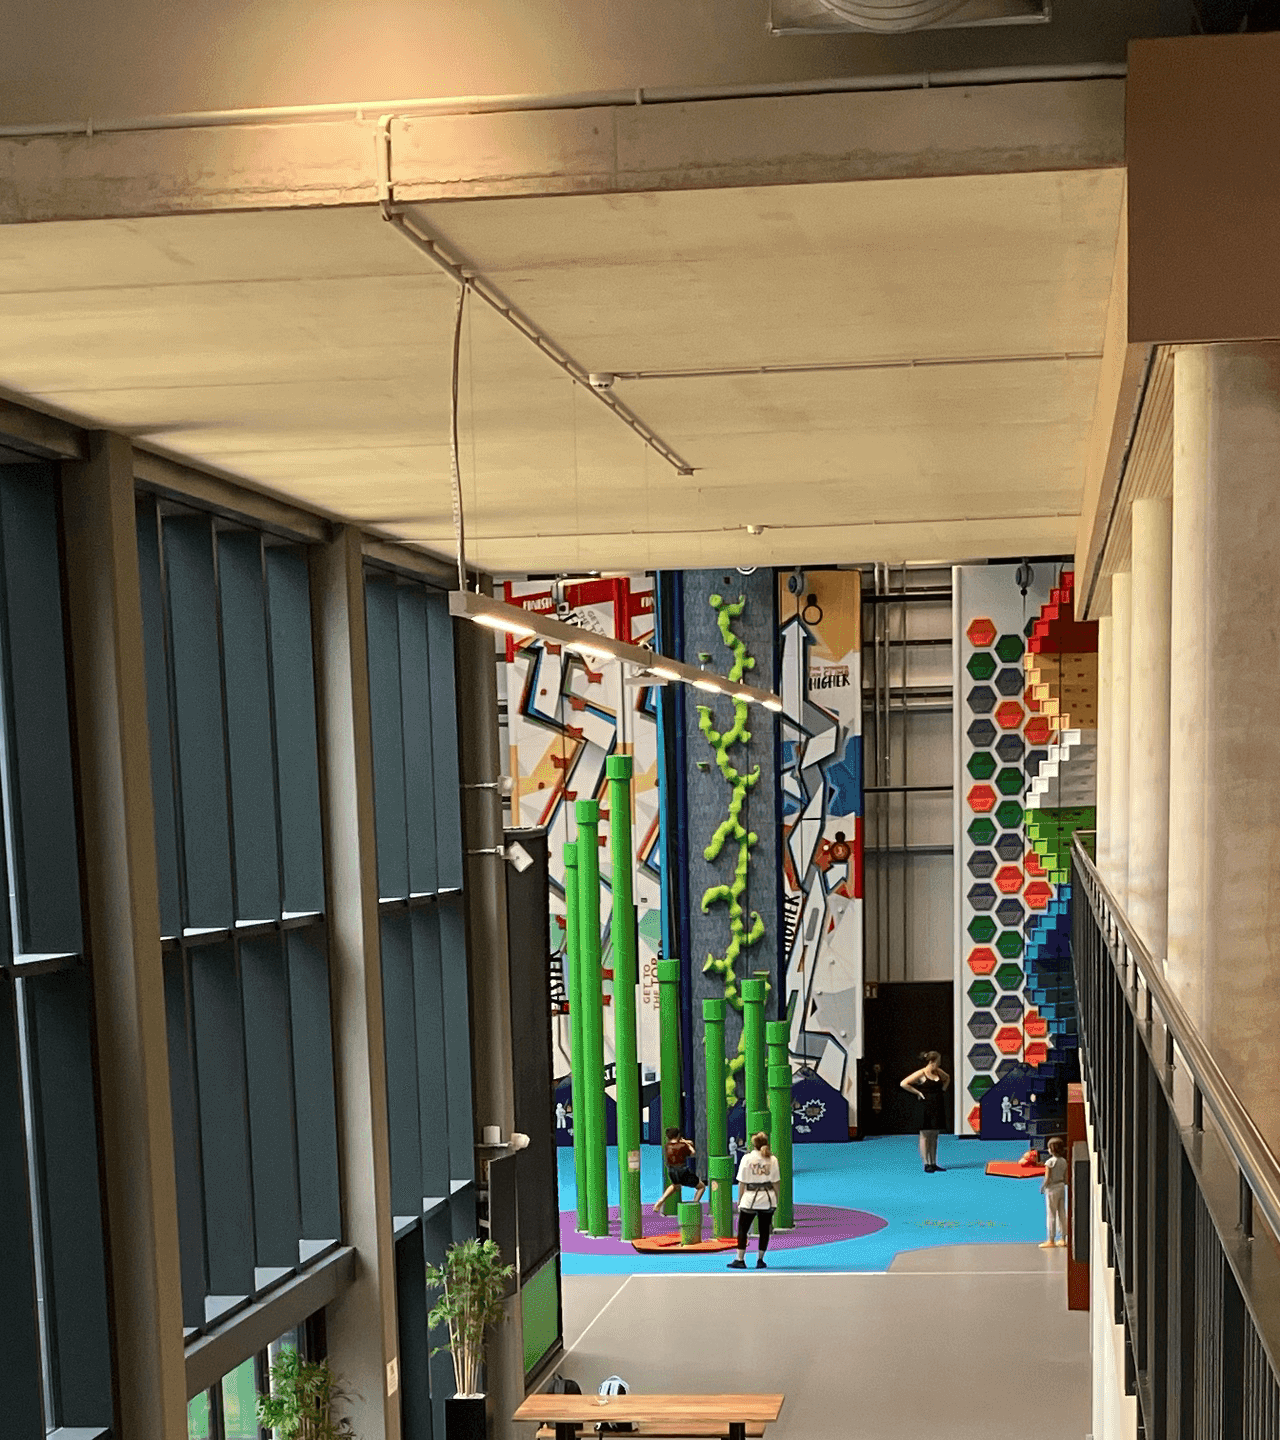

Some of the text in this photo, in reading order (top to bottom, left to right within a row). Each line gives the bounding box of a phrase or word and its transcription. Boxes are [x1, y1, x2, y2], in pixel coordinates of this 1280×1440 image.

[809, 674, 850, 691] HIGHER
[643, 964, 652, 1004] GET TO
